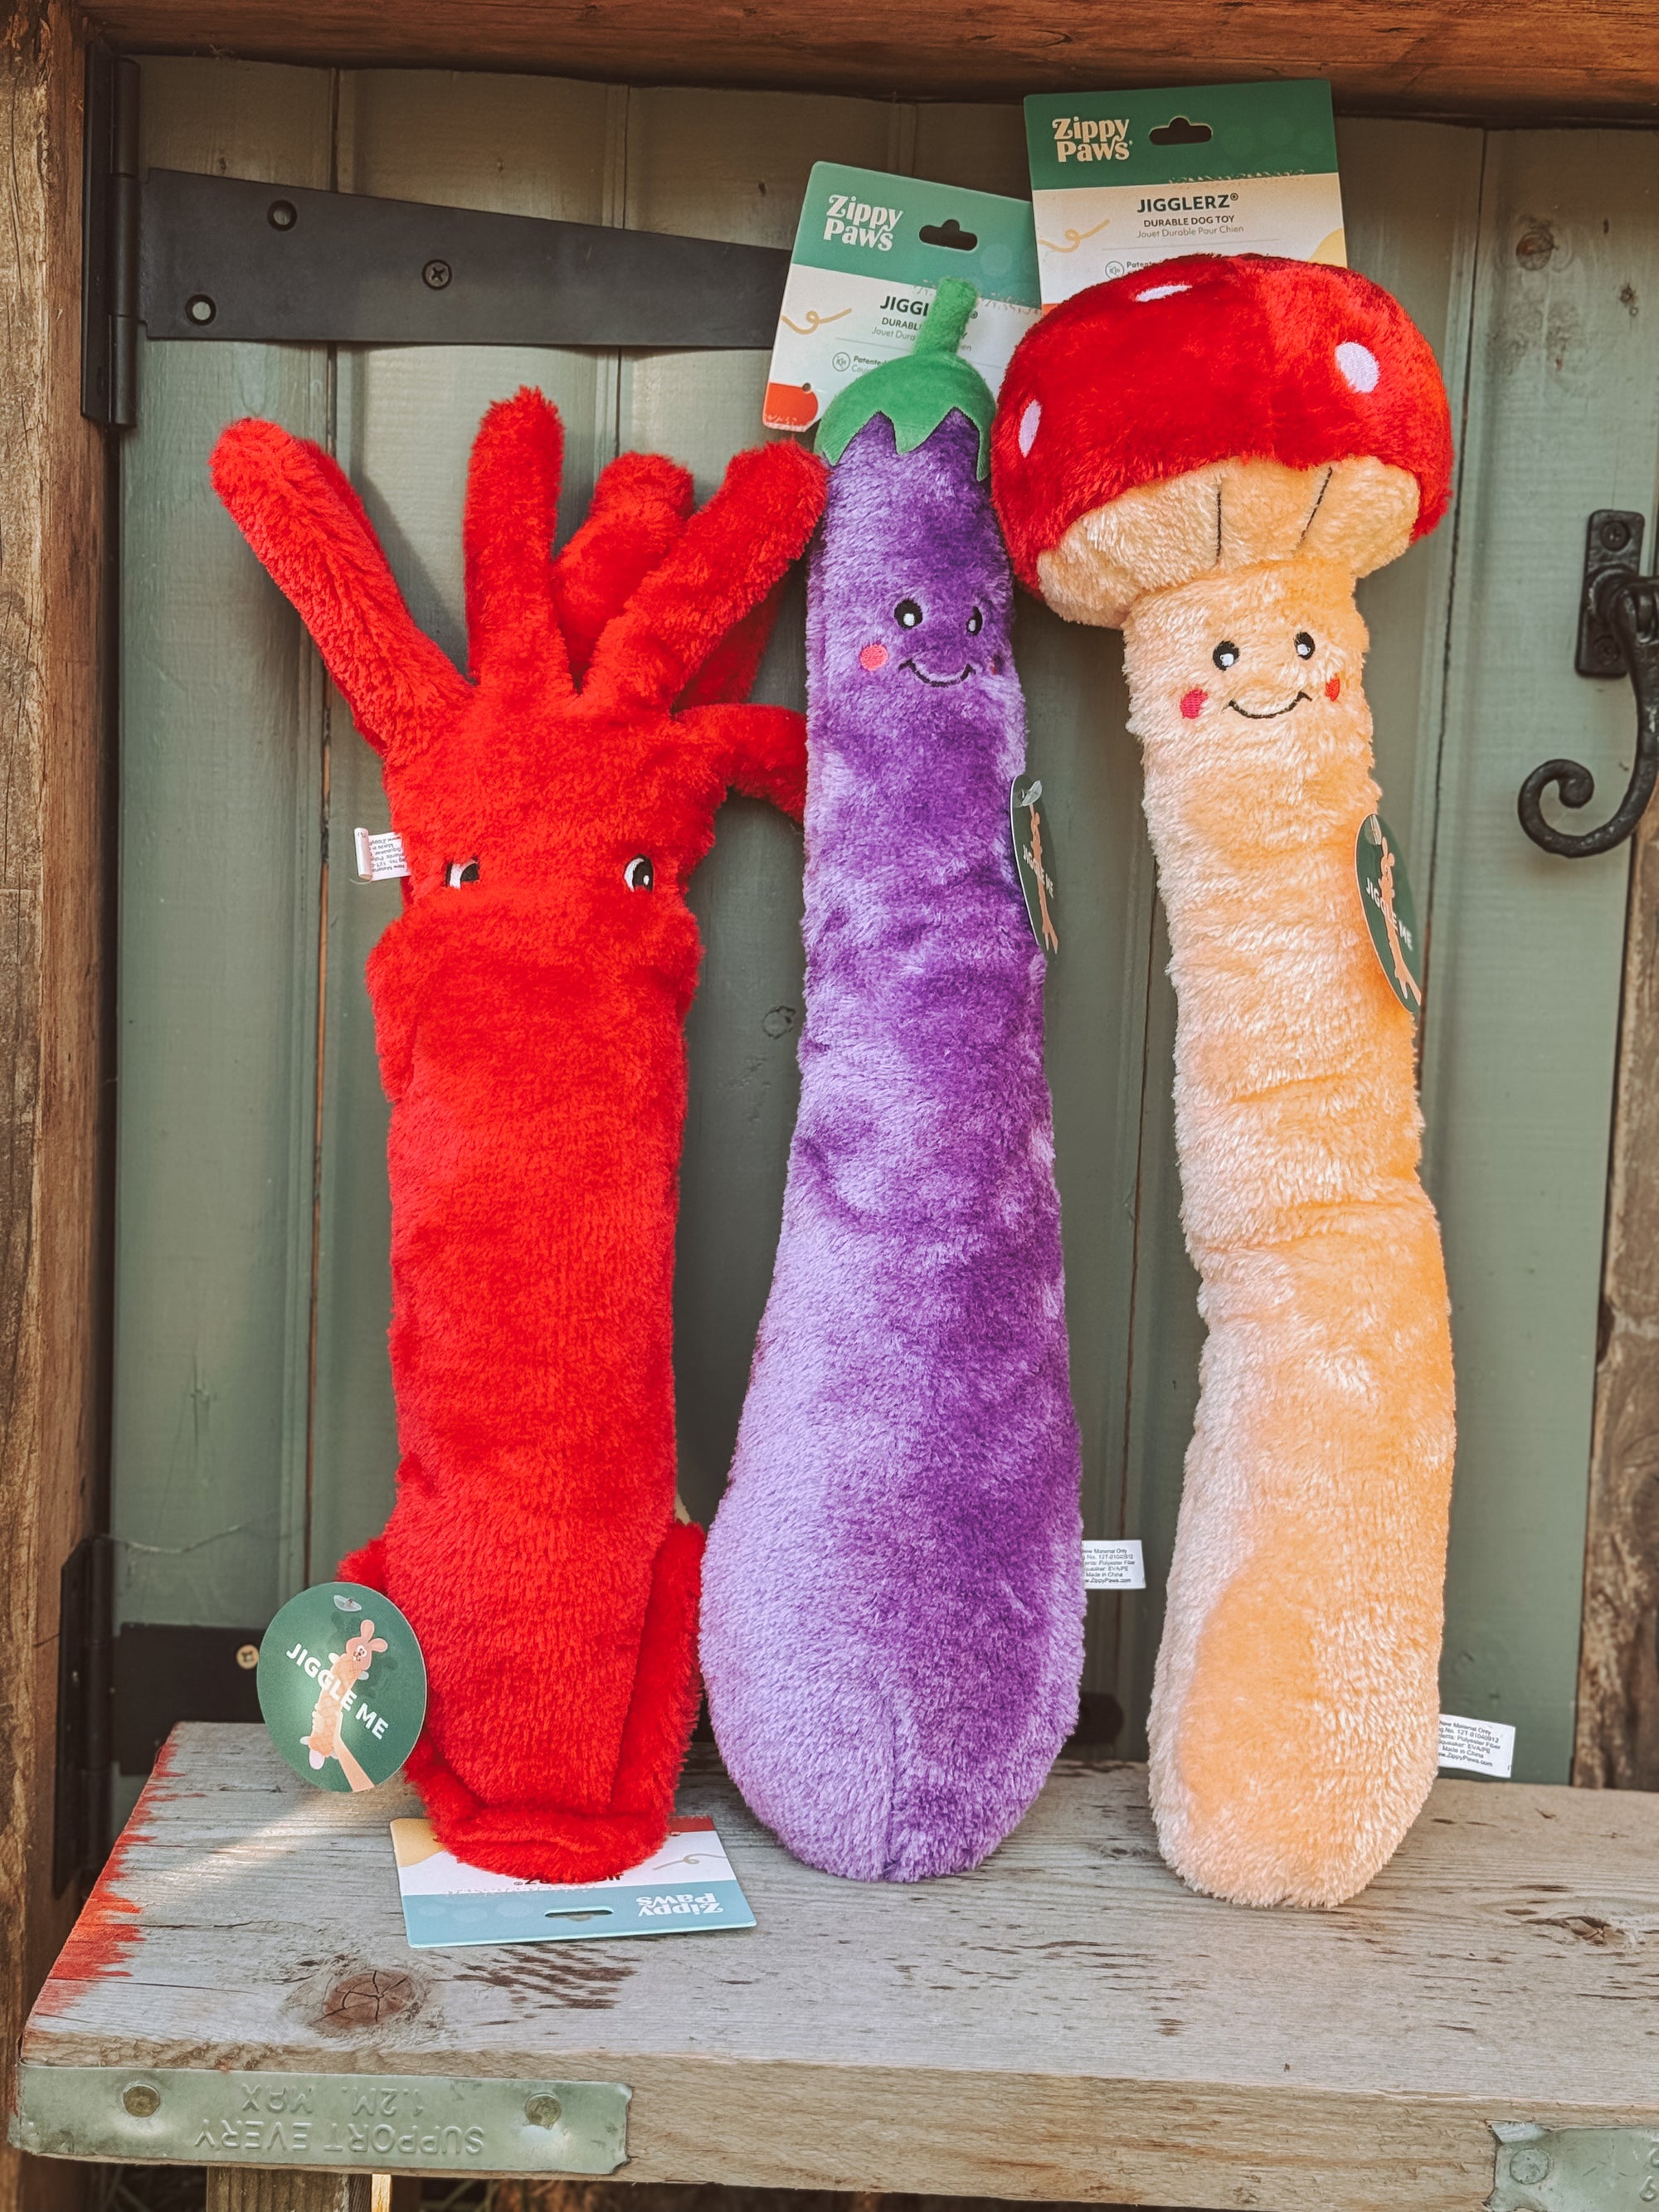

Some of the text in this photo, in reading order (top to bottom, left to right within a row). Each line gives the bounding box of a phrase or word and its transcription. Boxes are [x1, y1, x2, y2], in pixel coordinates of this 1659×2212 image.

[1052, 115, 1130, 143] Zippy
[826, 194, 903, 232] Zippy
[1143, 214, 1235, 227] DURABLE DOG TOY
[823, 217, 893, 251] Paws
[1136, 225, 1244, 239] Jouet Durable Pour Chien
[872, 326, 916, 342] Jouet Dura
[881, 317, 922, 331] DURABL
[1366, 877, 1413, 951] JIGGLE ME
[285, 1643, 389, 1740] JIGGLE ME
[636, 1892, 717, 1909] Paws
[638, 1902, 724, 1918] Zippy
[241, 2082, 315, 2114] MAX
[194, 2118, 484, 2155] SUPPORT EVERY
